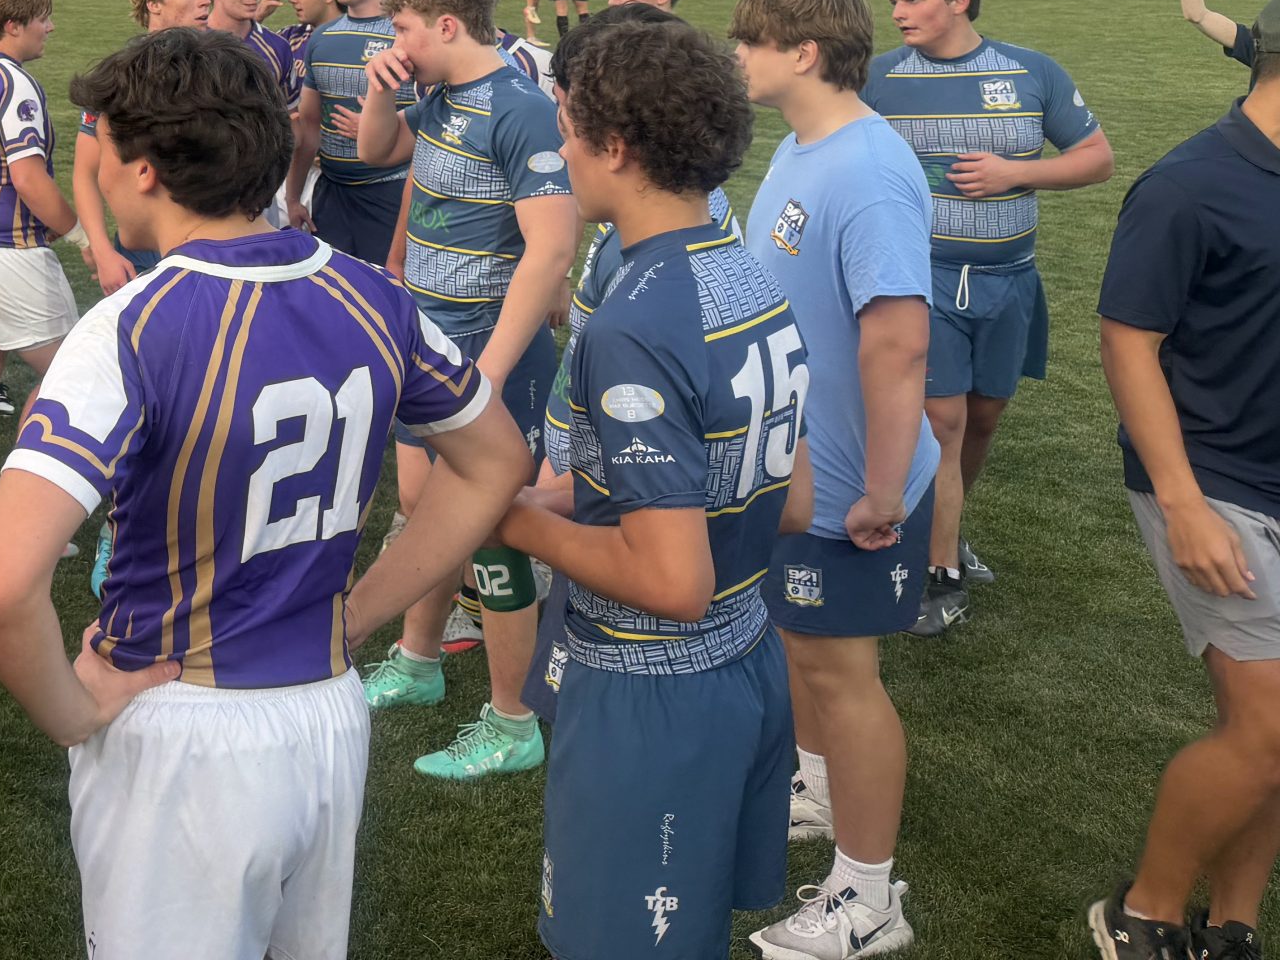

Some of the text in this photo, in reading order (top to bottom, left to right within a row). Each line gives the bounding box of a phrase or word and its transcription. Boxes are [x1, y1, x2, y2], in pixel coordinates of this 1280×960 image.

[622, 386, 635, 396] 13
[627, 409, 636, 419] 8
[730, 322, 810, 499] 15
[240, 365, 374, 564] 21
[611, 454, 677, 465] KIA KAHA
[473, 563, 514, 597] 02
[788, 568, 818, 582] 901
